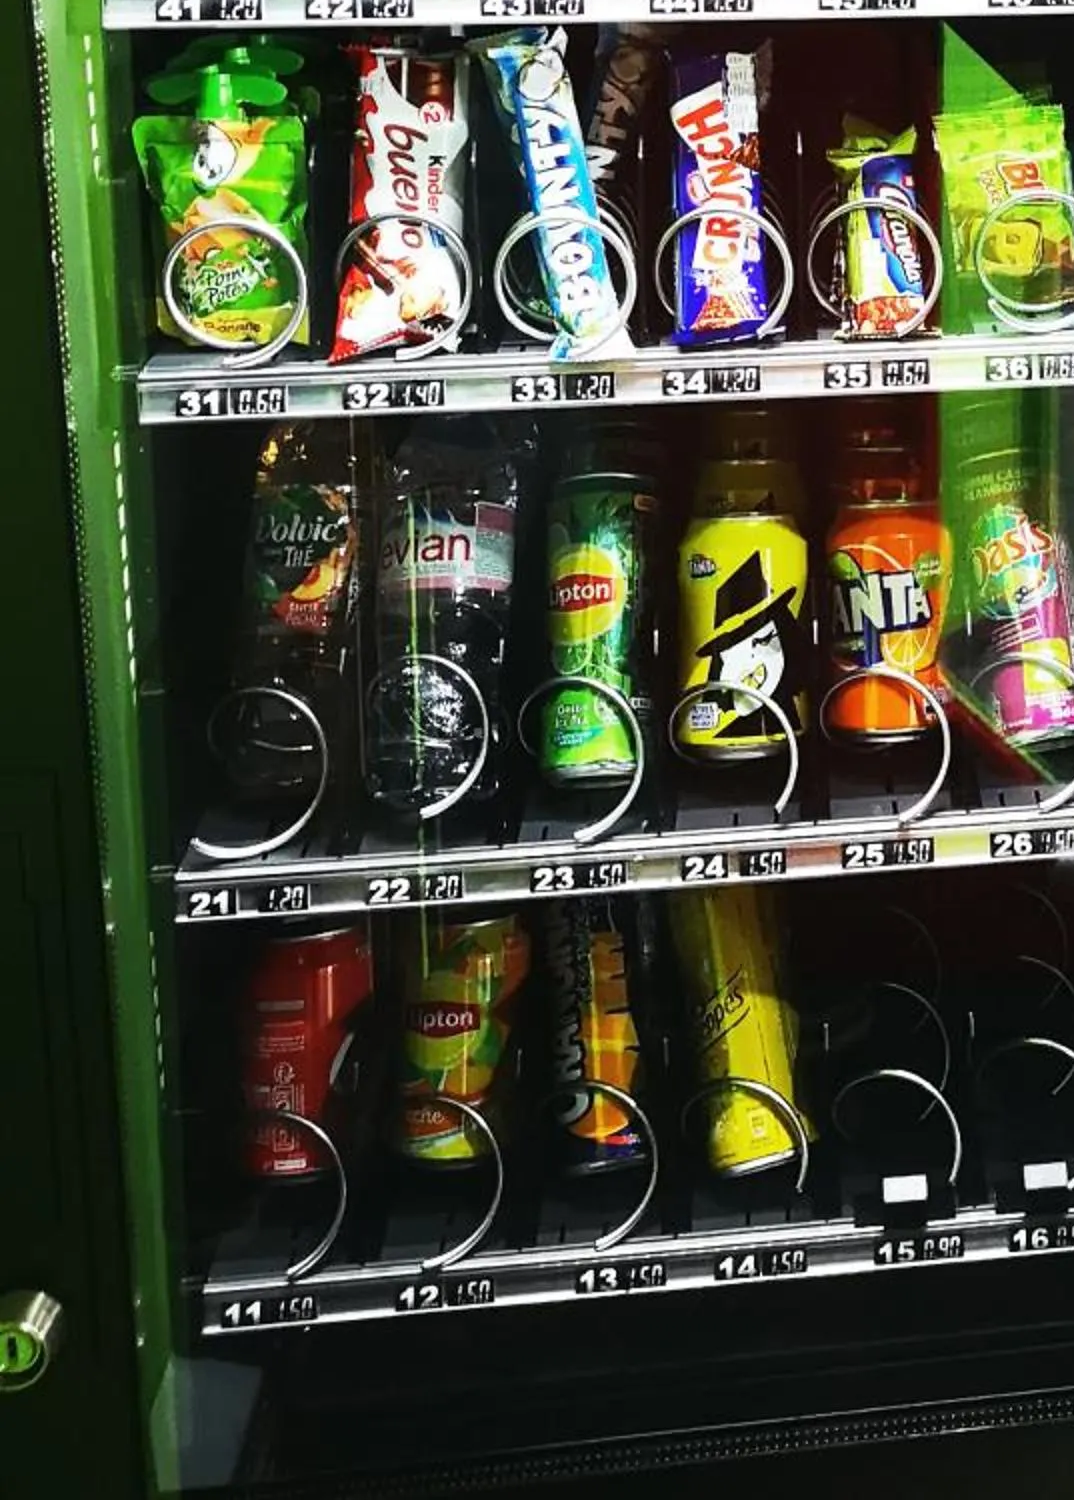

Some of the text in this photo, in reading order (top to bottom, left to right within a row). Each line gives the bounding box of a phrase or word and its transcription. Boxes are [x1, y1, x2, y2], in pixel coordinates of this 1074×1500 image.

[381, 121, 426, 250] bueno
[424, 154, 447, 213] Kinder
[676, 98, 748, 268] CRUNCH
[664, 368, 757, 395] 34 1.20
[827, 360, 927, 388] 35 0.60
[988, 356, 1030, 381] 36
[346, 379, 441, 409] 32 1.40
[514, 374, 612, 402] 33 1.20
[179, 389, 284, 416] 31 0.60
[382, 528, 471, 570] evian
[832, 569, 932, 634] ANTA
[845, 843, 885, 867] 25
[994, 833, 1033, 856] 26
[535, 863, 623, 891] 23 1.50
[685, 851, 784, 880] 24 1.50
[190, 887, 305, 917] 21 1.20
[368, 874, 461, 903] 22 1.20
[878, 1236, 961, 1263] 15 0.90
[1012, 1227, 1049, 1251] 16
[579, 1265, 663, 1292] 13 1.50
[718, 1251, 805, 1279] 14 1.50
[399, 1280, 492, 1309] 12 1.50
[224, 1296, 313, 1326] 11 1.50
